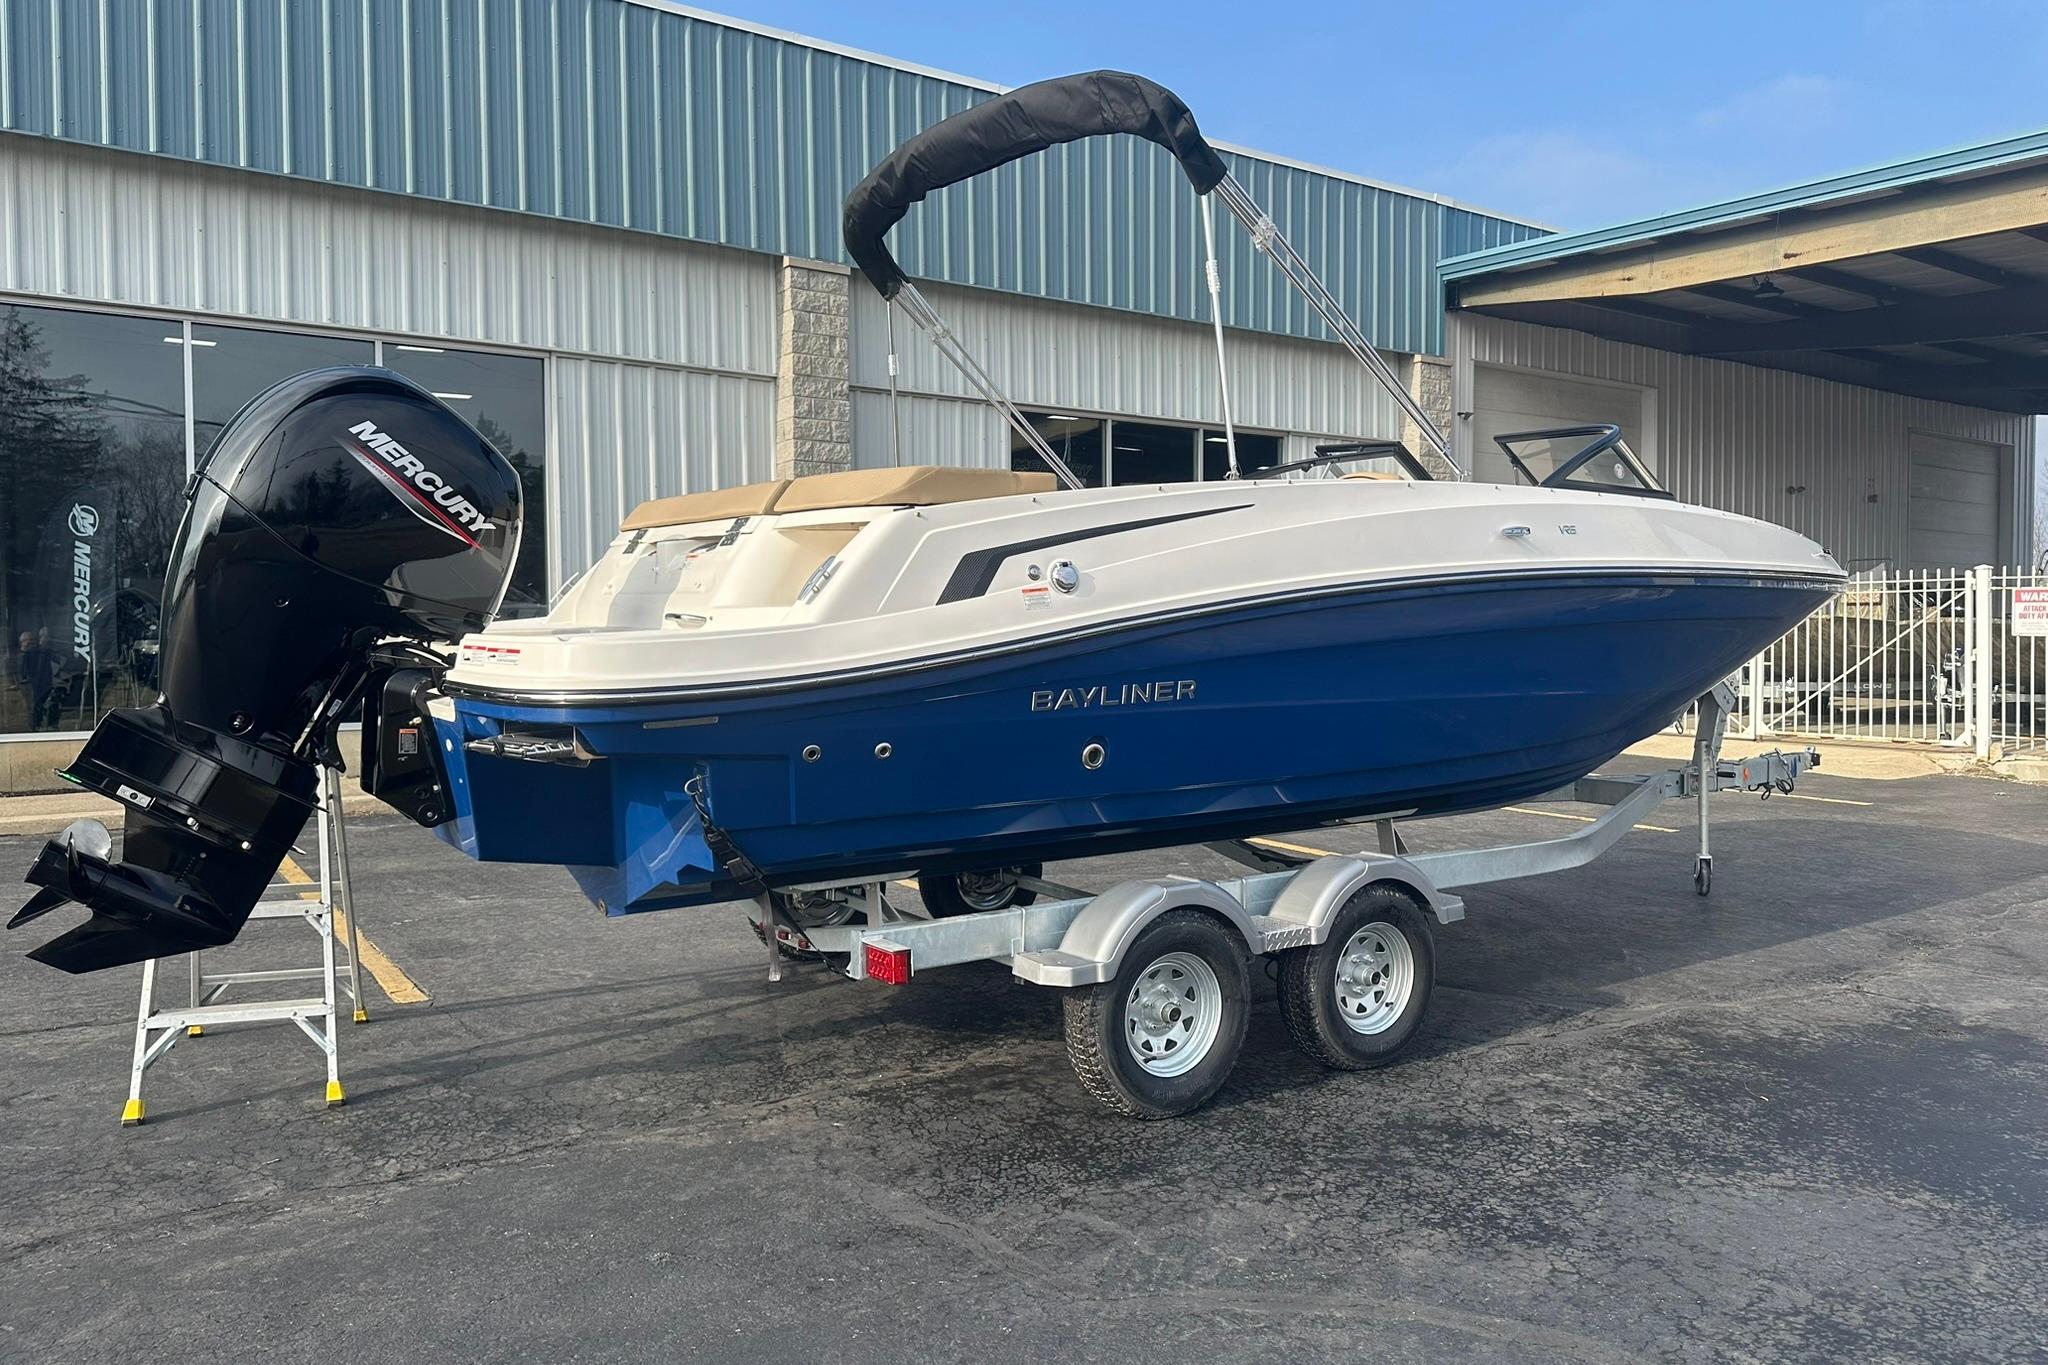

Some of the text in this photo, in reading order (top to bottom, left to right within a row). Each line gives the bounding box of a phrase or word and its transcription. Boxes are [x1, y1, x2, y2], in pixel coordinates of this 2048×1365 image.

[348, 420, 497, 532] MERCURY
[73, 540, 91, 663] MERCURY
[1031, 679, 1197, 712] BAYLINER
